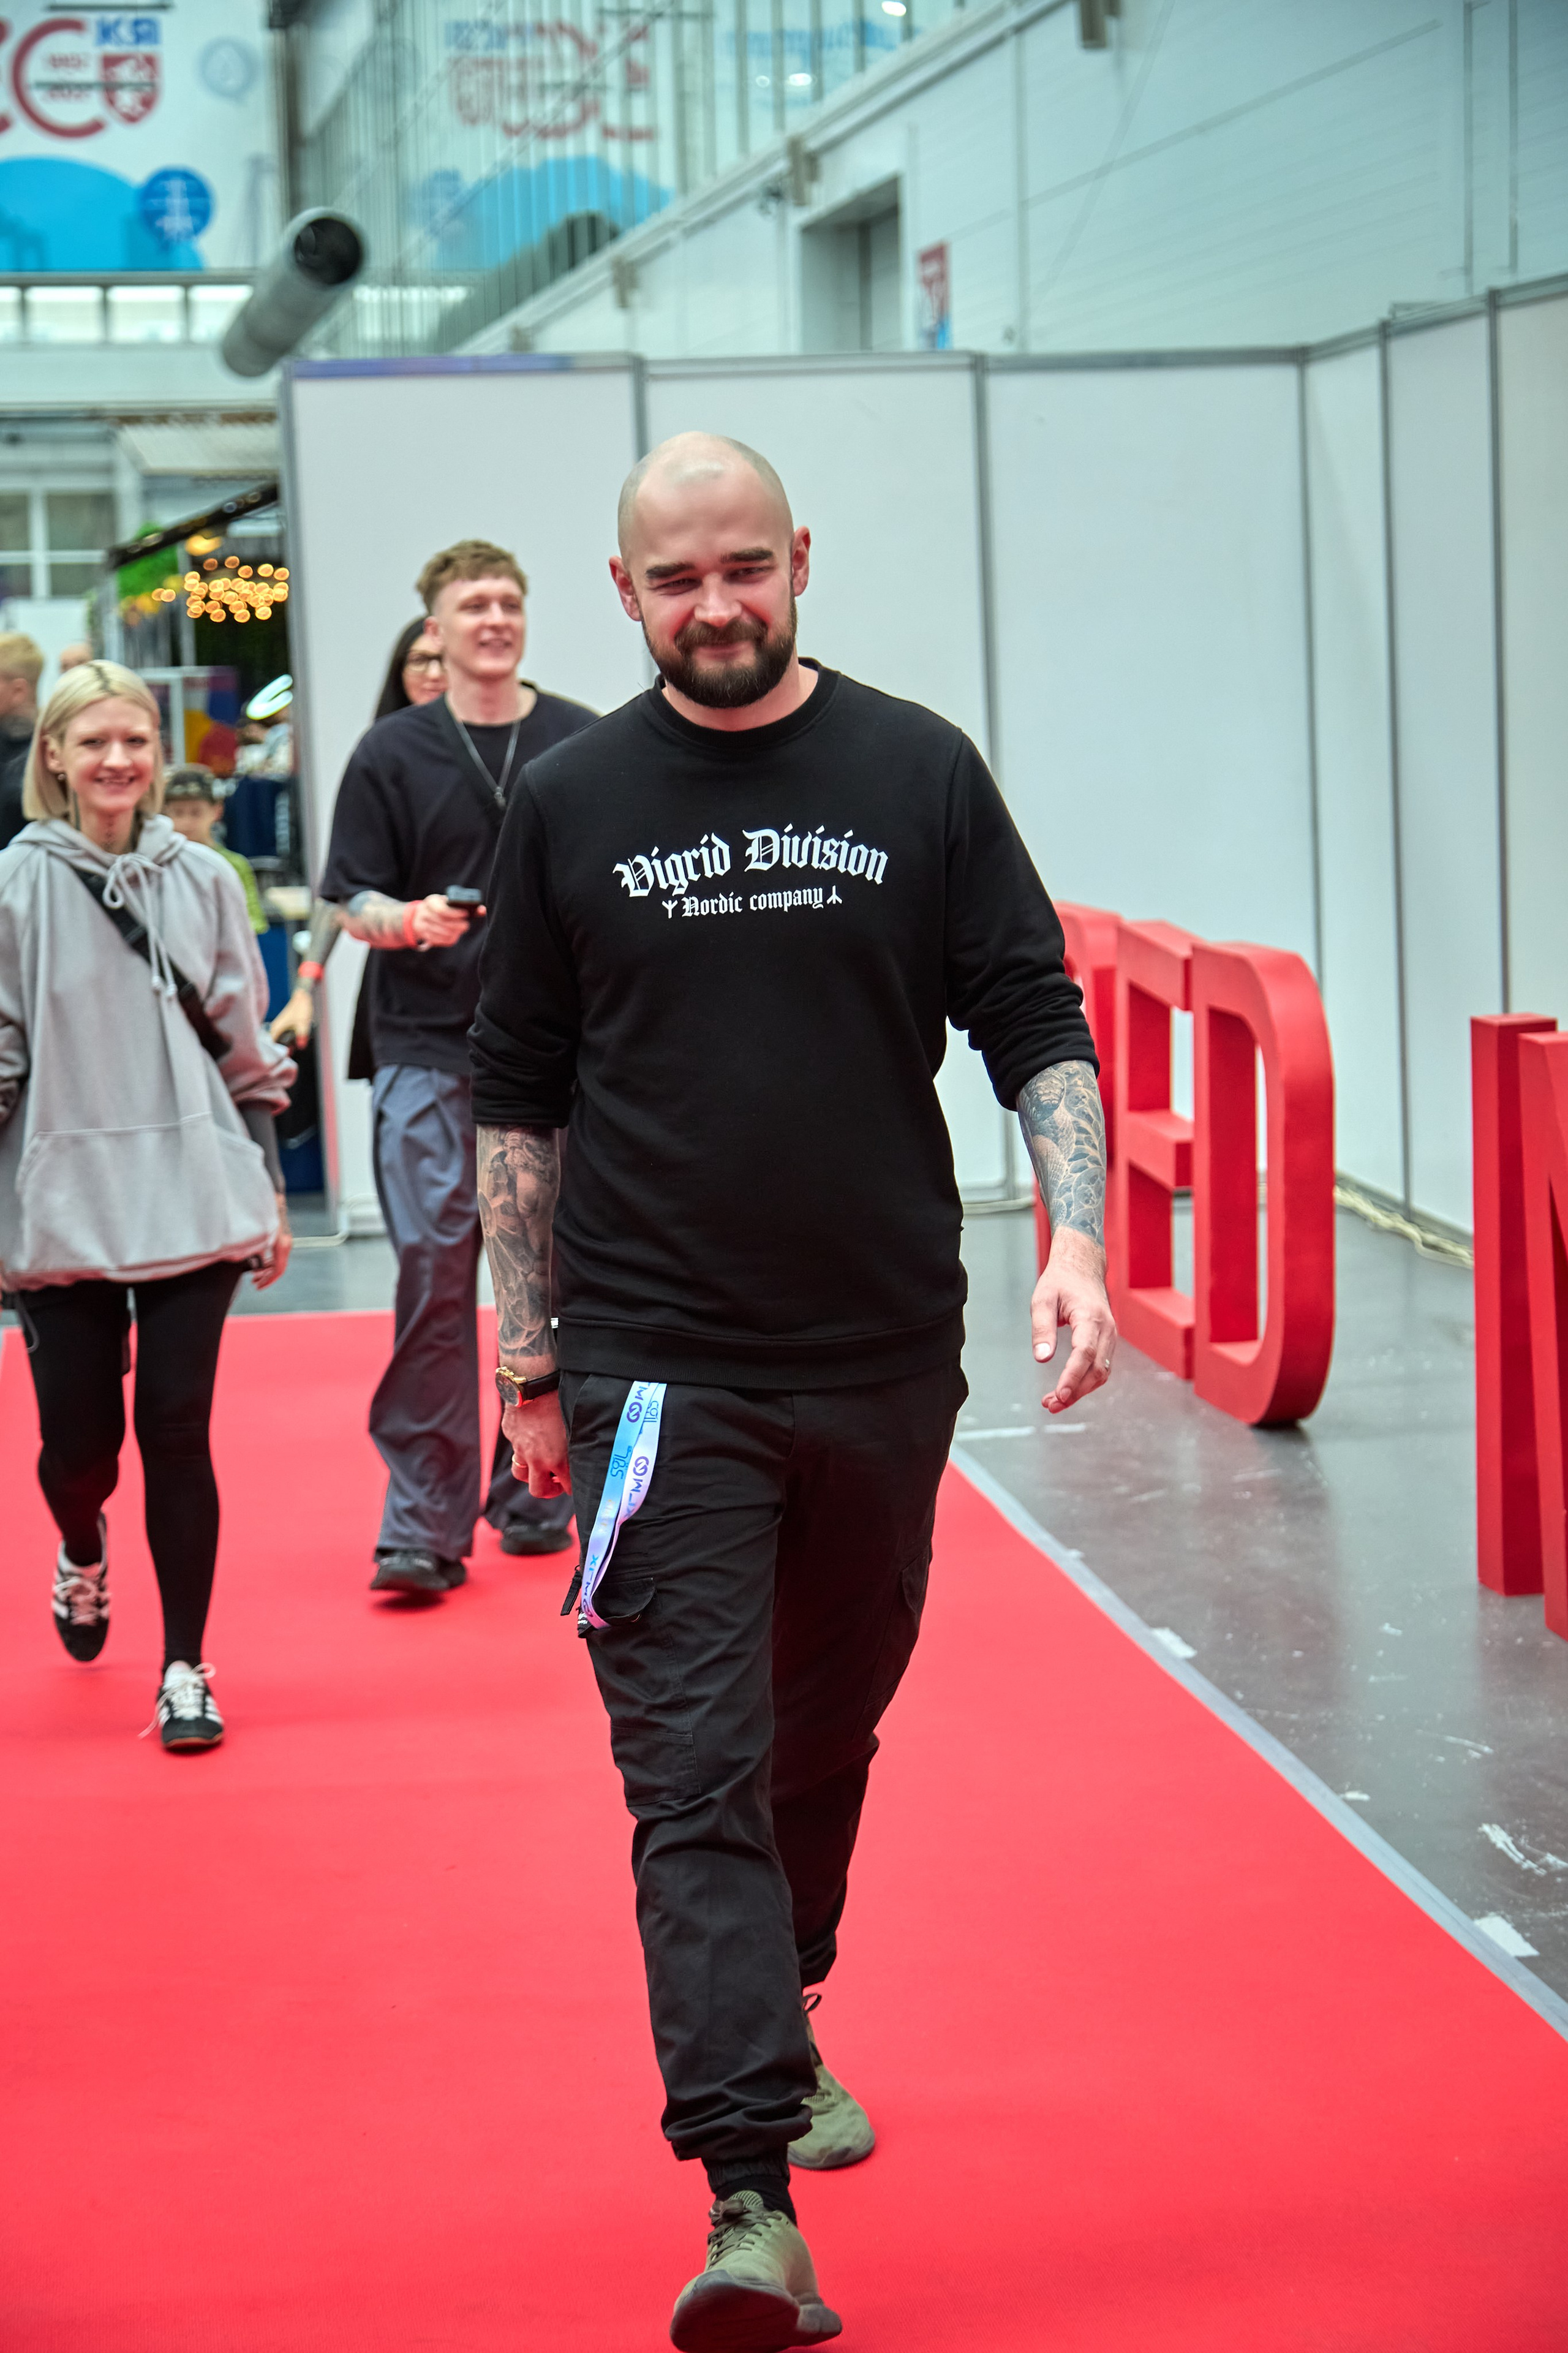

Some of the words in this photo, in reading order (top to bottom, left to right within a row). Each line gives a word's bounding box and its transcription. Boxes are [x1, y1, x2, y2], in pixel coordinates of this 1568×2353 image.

[612, 833, 731, 897] Vigrid
[742, 823, 889, 886] Division
[681, 891, 743, 917] Nordic
[749, 886, 824, 912] company
